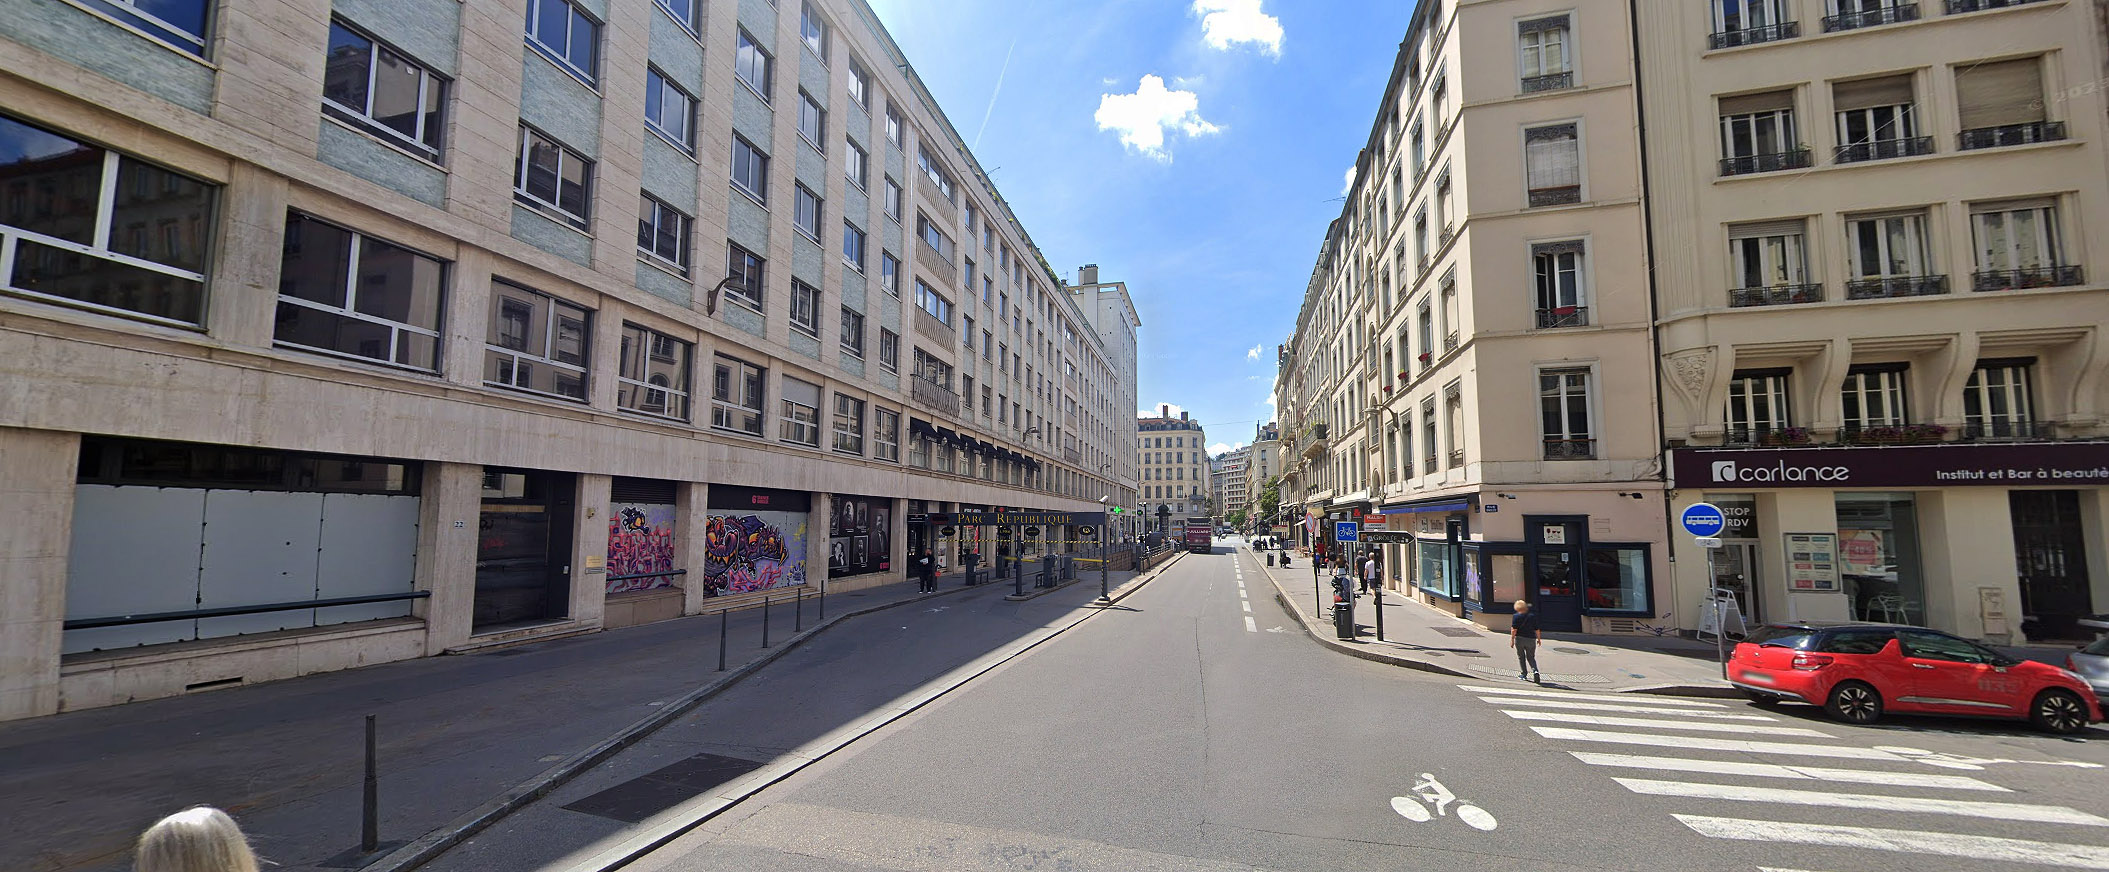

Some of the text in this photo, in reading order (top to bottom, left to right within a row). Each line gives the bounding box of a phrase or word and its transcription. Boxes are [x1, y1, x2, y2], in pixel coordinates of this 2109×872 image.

[1739, 460, 1850, 482] carlance
[1936, 468, 1984, 480] Institut
[1988, 469, 2004, 479] et
[2008, 469, 2033, 479] Bar
[2037, 467, 2047, 479] à
[1723, 507, 1750, 516] STOP
[957, 513, 986, 524] PARC
[1727, 518, 1750, 527] RDV
